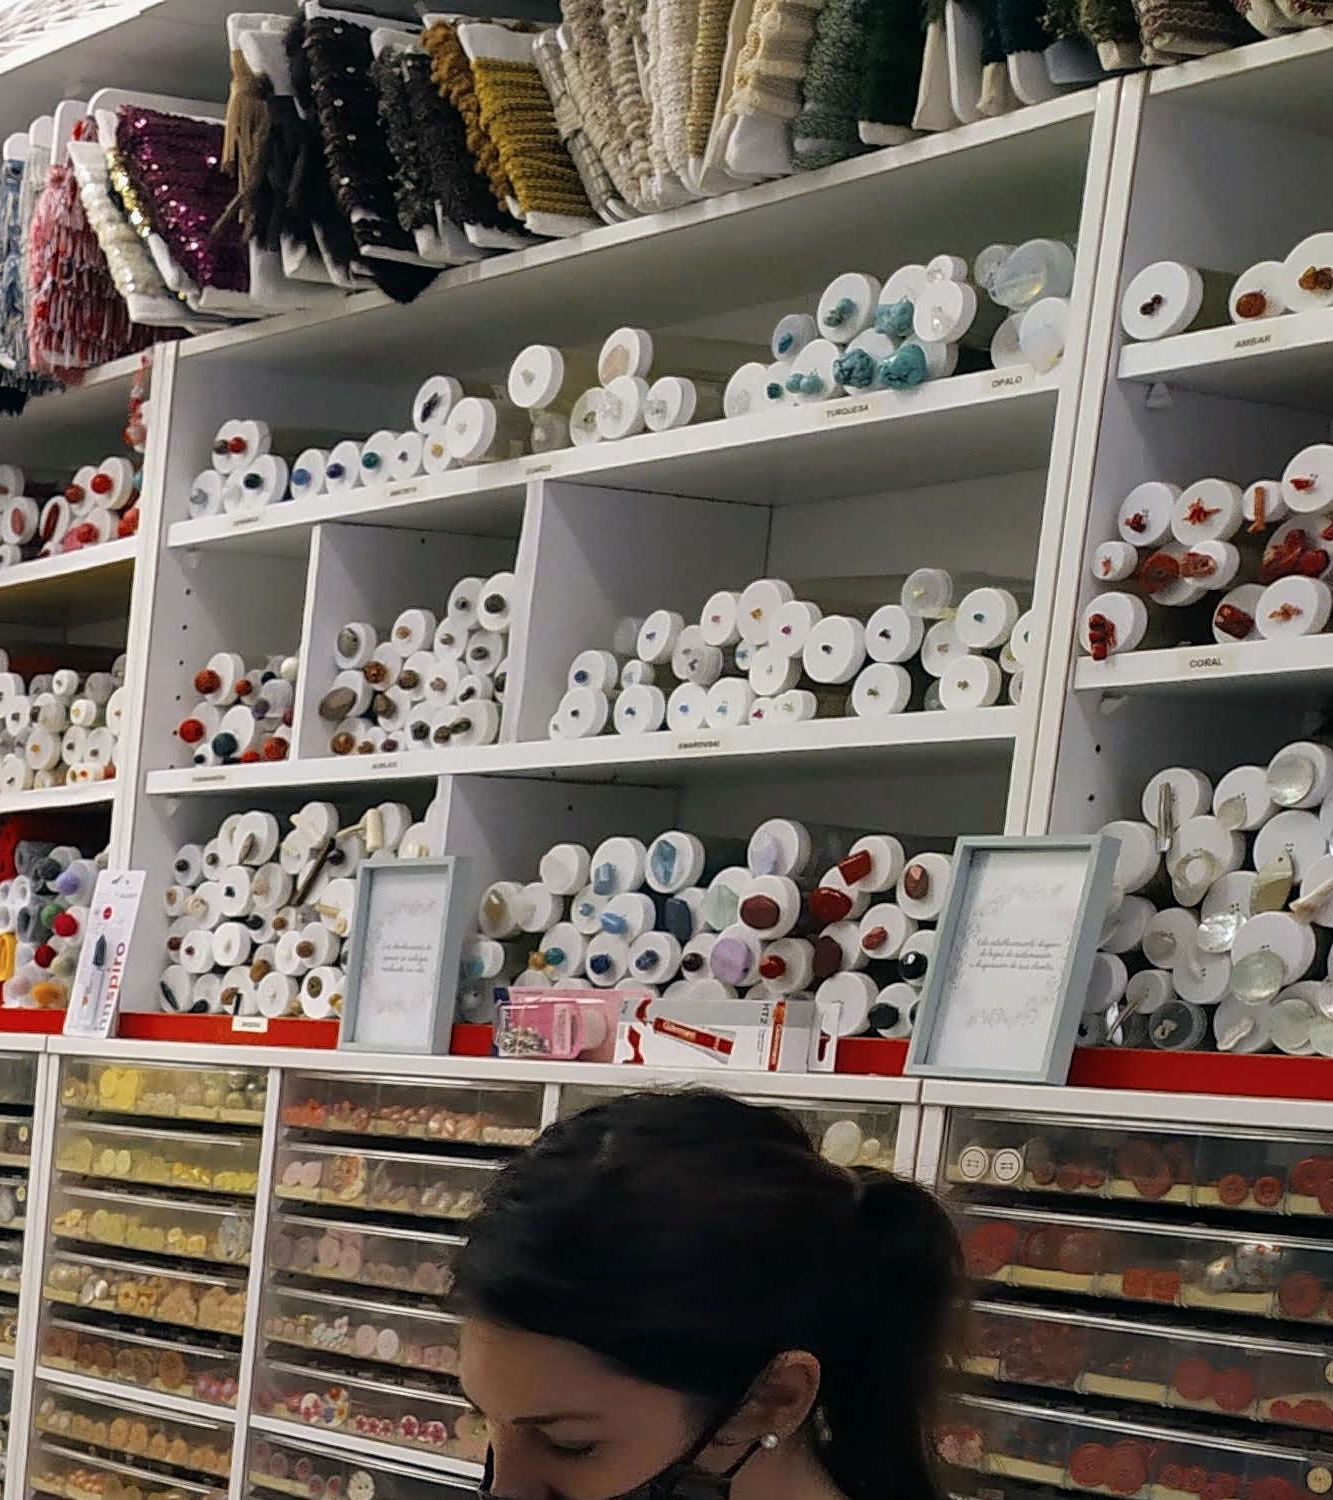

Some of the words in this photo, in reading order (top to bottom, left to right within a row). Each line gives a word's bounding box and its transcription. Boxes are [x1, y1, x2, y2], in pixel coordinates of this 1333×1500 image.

[1234, 333, 1272, 348] AMBAR
[991, 375, 1023, 388] OPALO
[1189, 657, 1223, 668] CORAL
